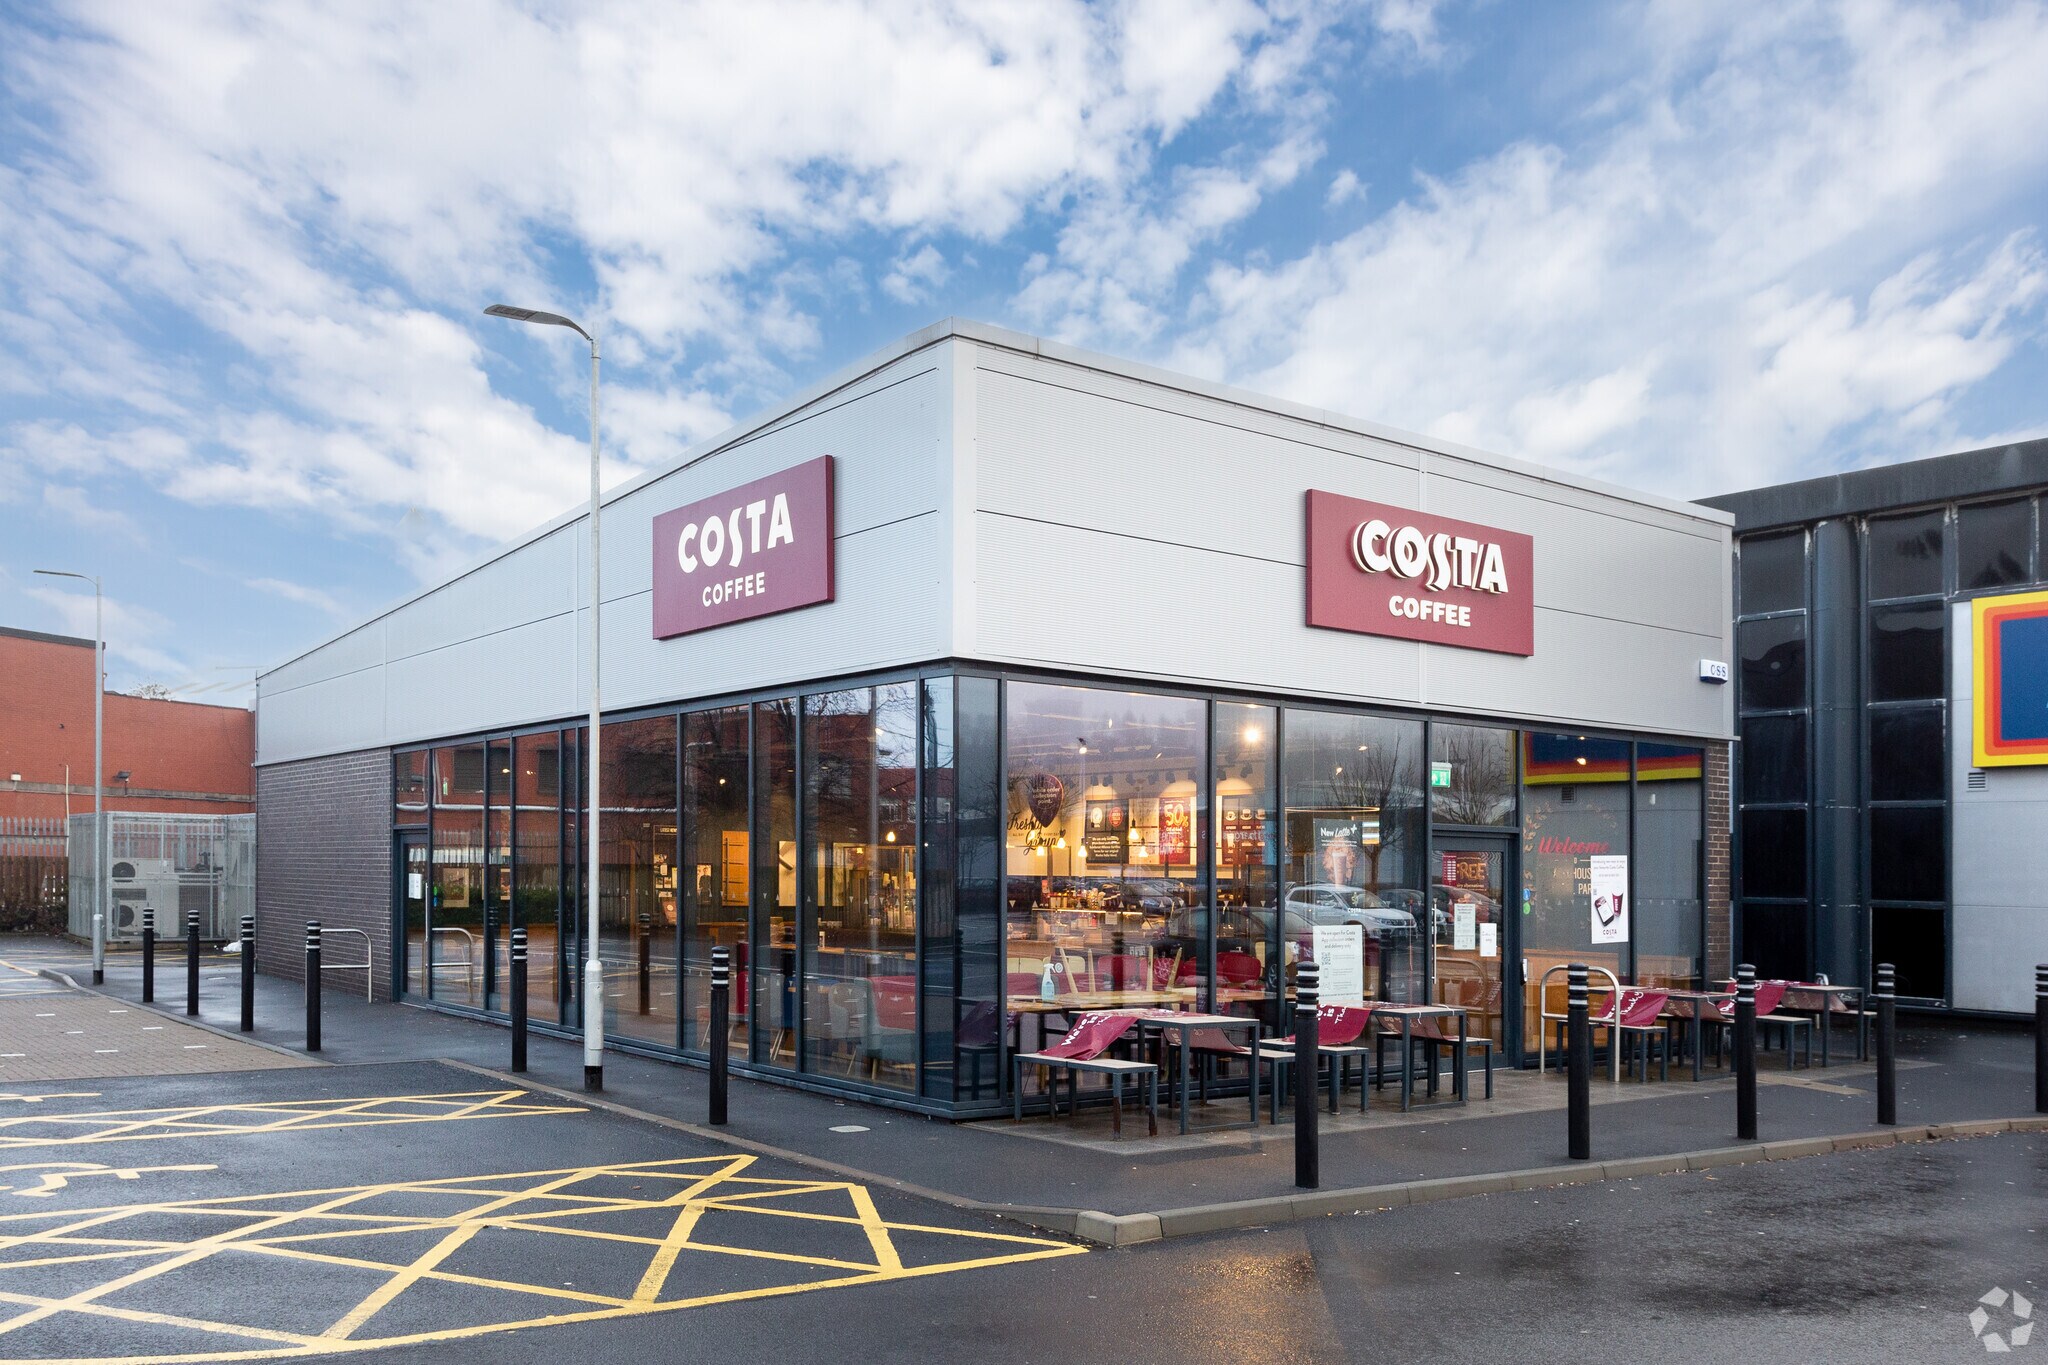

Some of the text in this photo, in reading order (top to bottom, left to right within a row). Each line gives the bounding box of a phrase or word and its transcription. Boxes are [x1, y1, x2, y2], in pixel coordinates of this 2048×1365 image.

[678, 492, 794, 574] COSTA
[1353, 519, 1509, 595] COSTA
[702, 571, 766, 608] COFFEE
[1388, 595, 1472, 628] COFFEE
[1163, 803, 1189, 828] 50%
[1320, 827, 1334, 837] New
[1538, 836, 1610, 855] Welcome
